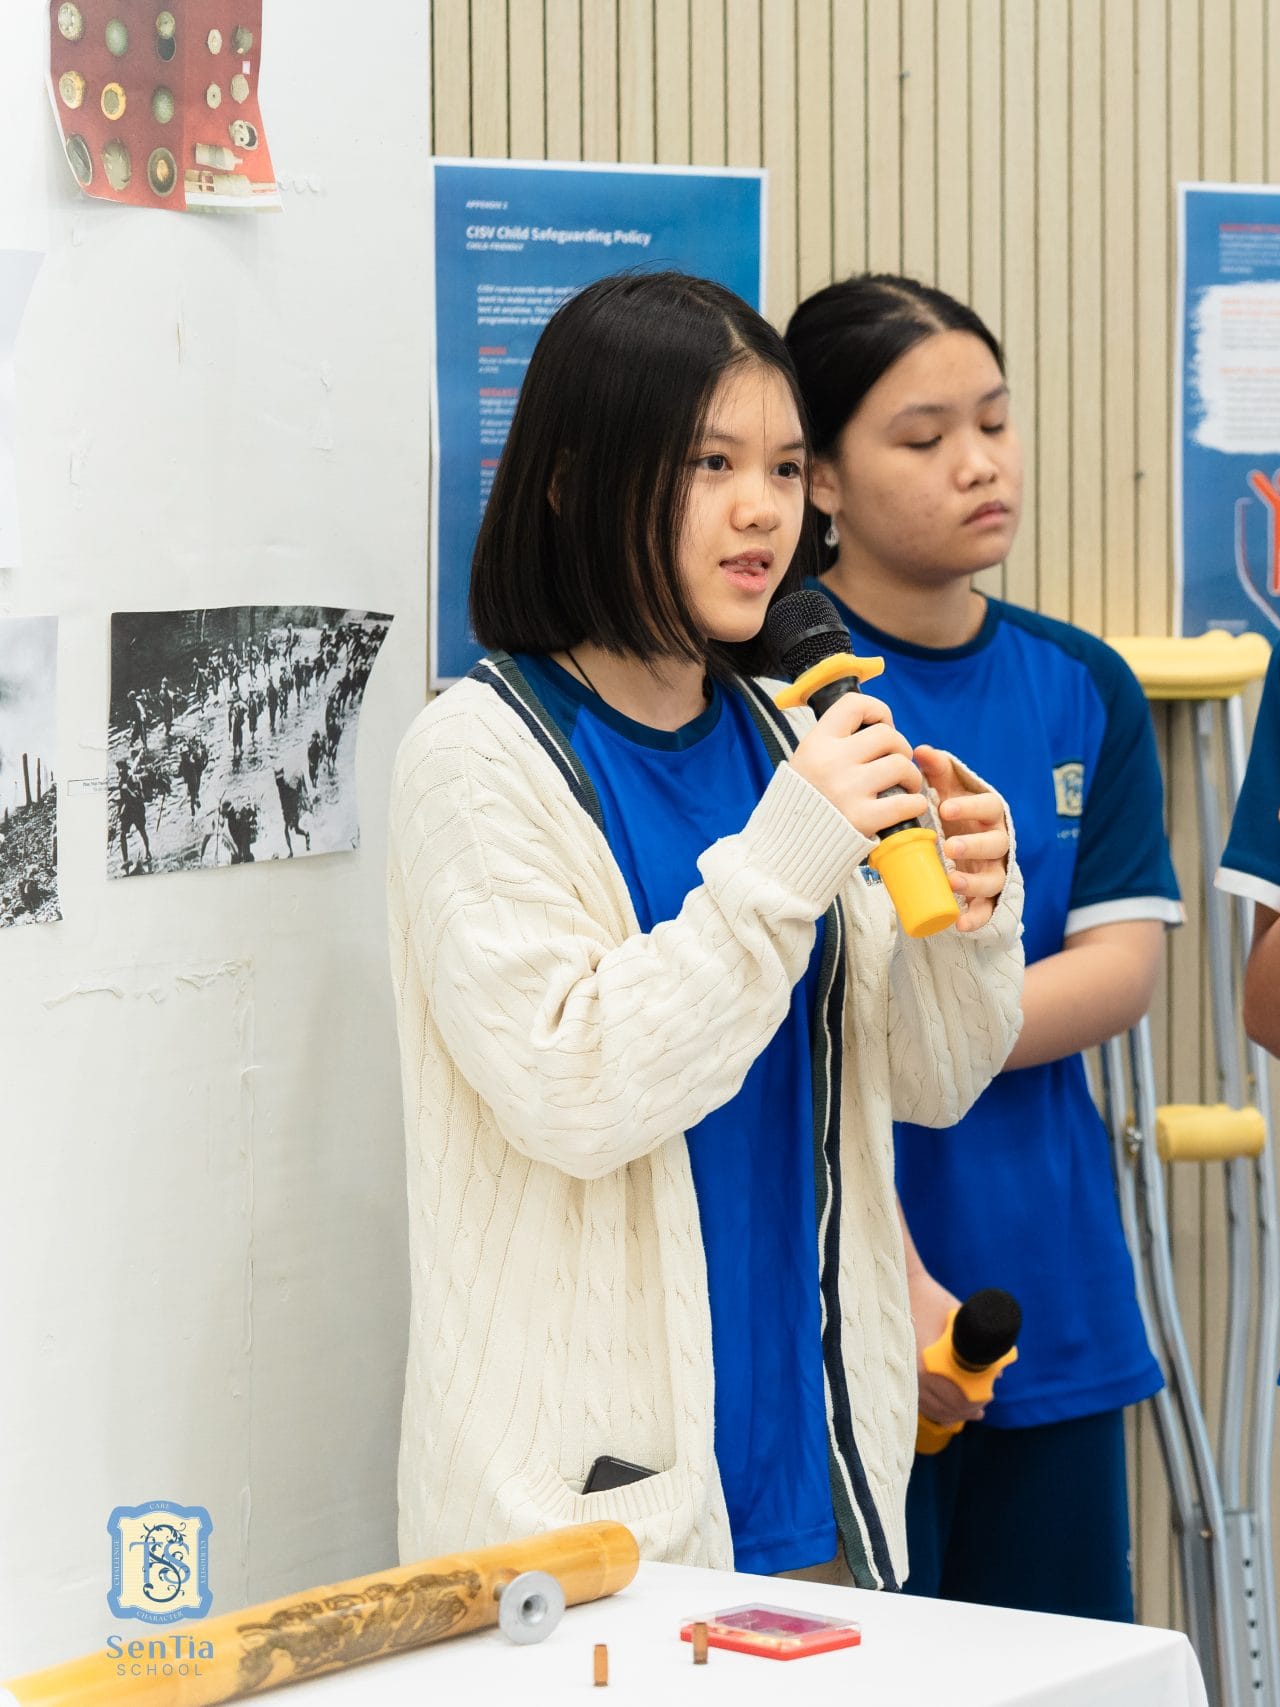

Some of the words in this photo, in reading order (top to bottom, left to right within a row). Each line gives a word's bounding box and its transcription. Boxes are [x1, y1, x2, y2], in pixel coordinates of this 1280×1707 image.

[466, 225, 495, 239] CISV
[497, 226, 529, 240] Child
[531, 227, 612, 246] Safeguarding
[614, 230, 652, 247] Policy
